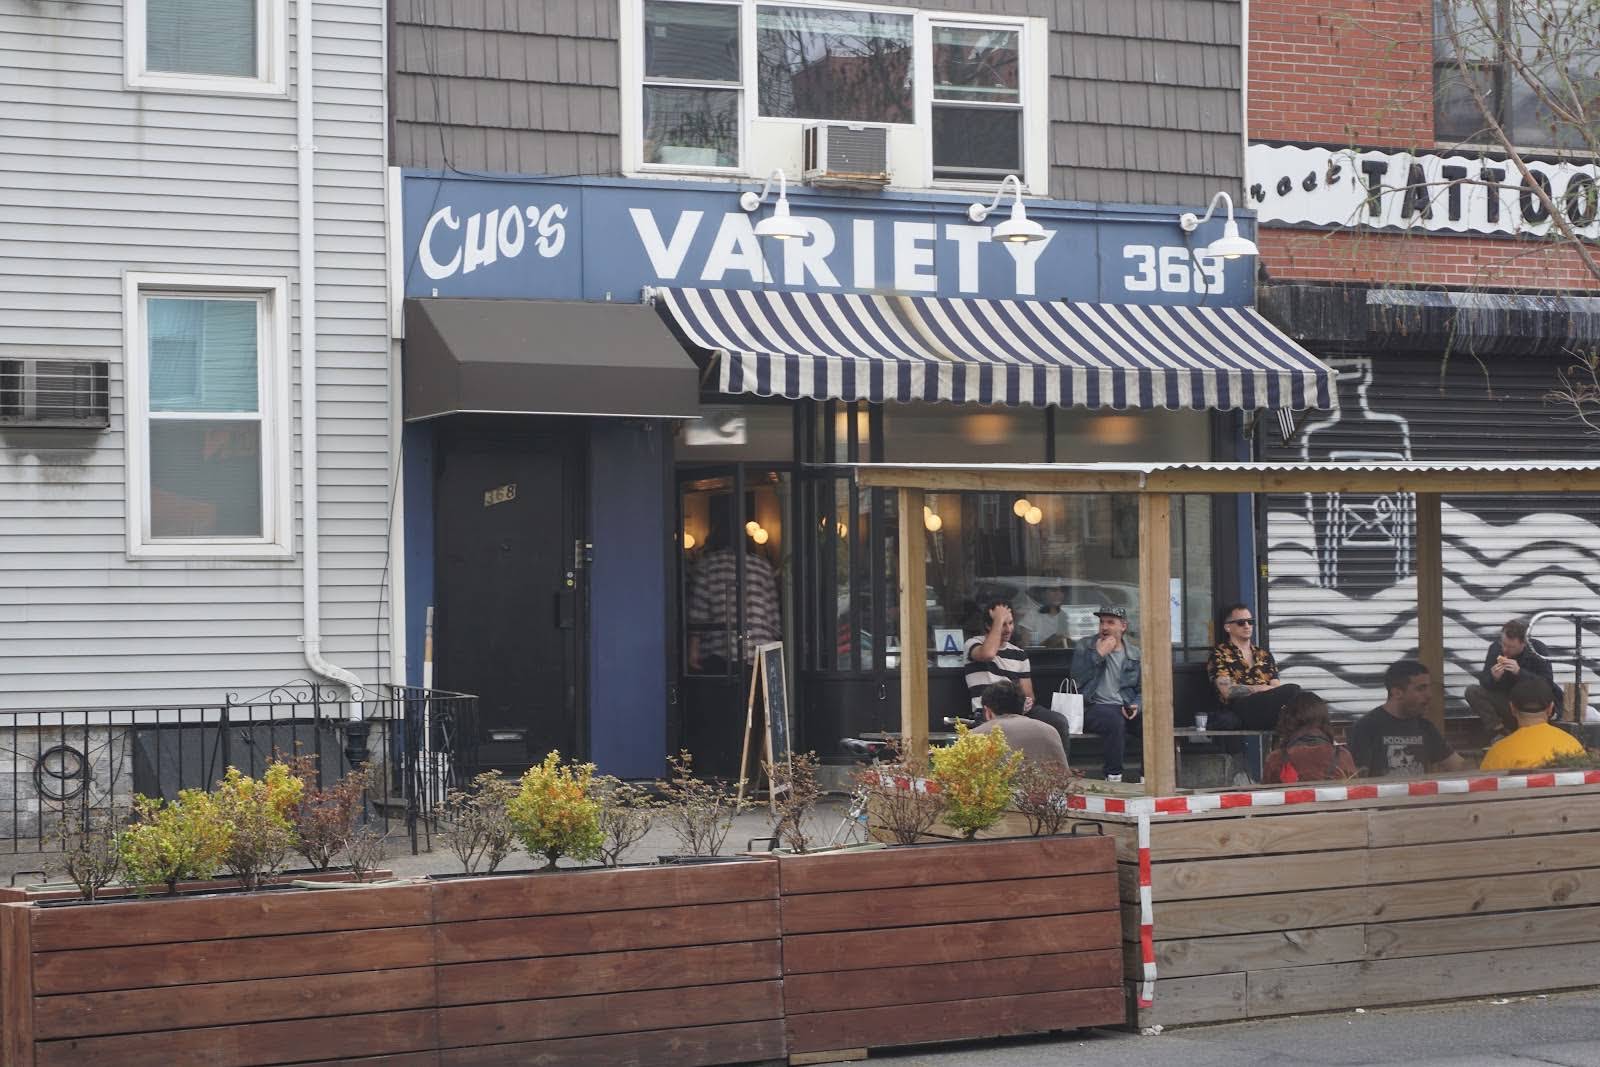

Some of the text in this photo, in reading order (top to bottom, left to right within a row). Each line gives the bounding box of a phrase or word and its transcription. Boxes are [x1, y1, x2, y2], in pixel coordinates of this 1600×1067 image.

[1362, 160, 1598, 229] TATTOO
[629, 207, 1058, 296] VARIETY
[1123, 244, 1225, 294] 368
[944, 634, 959, 652] A
